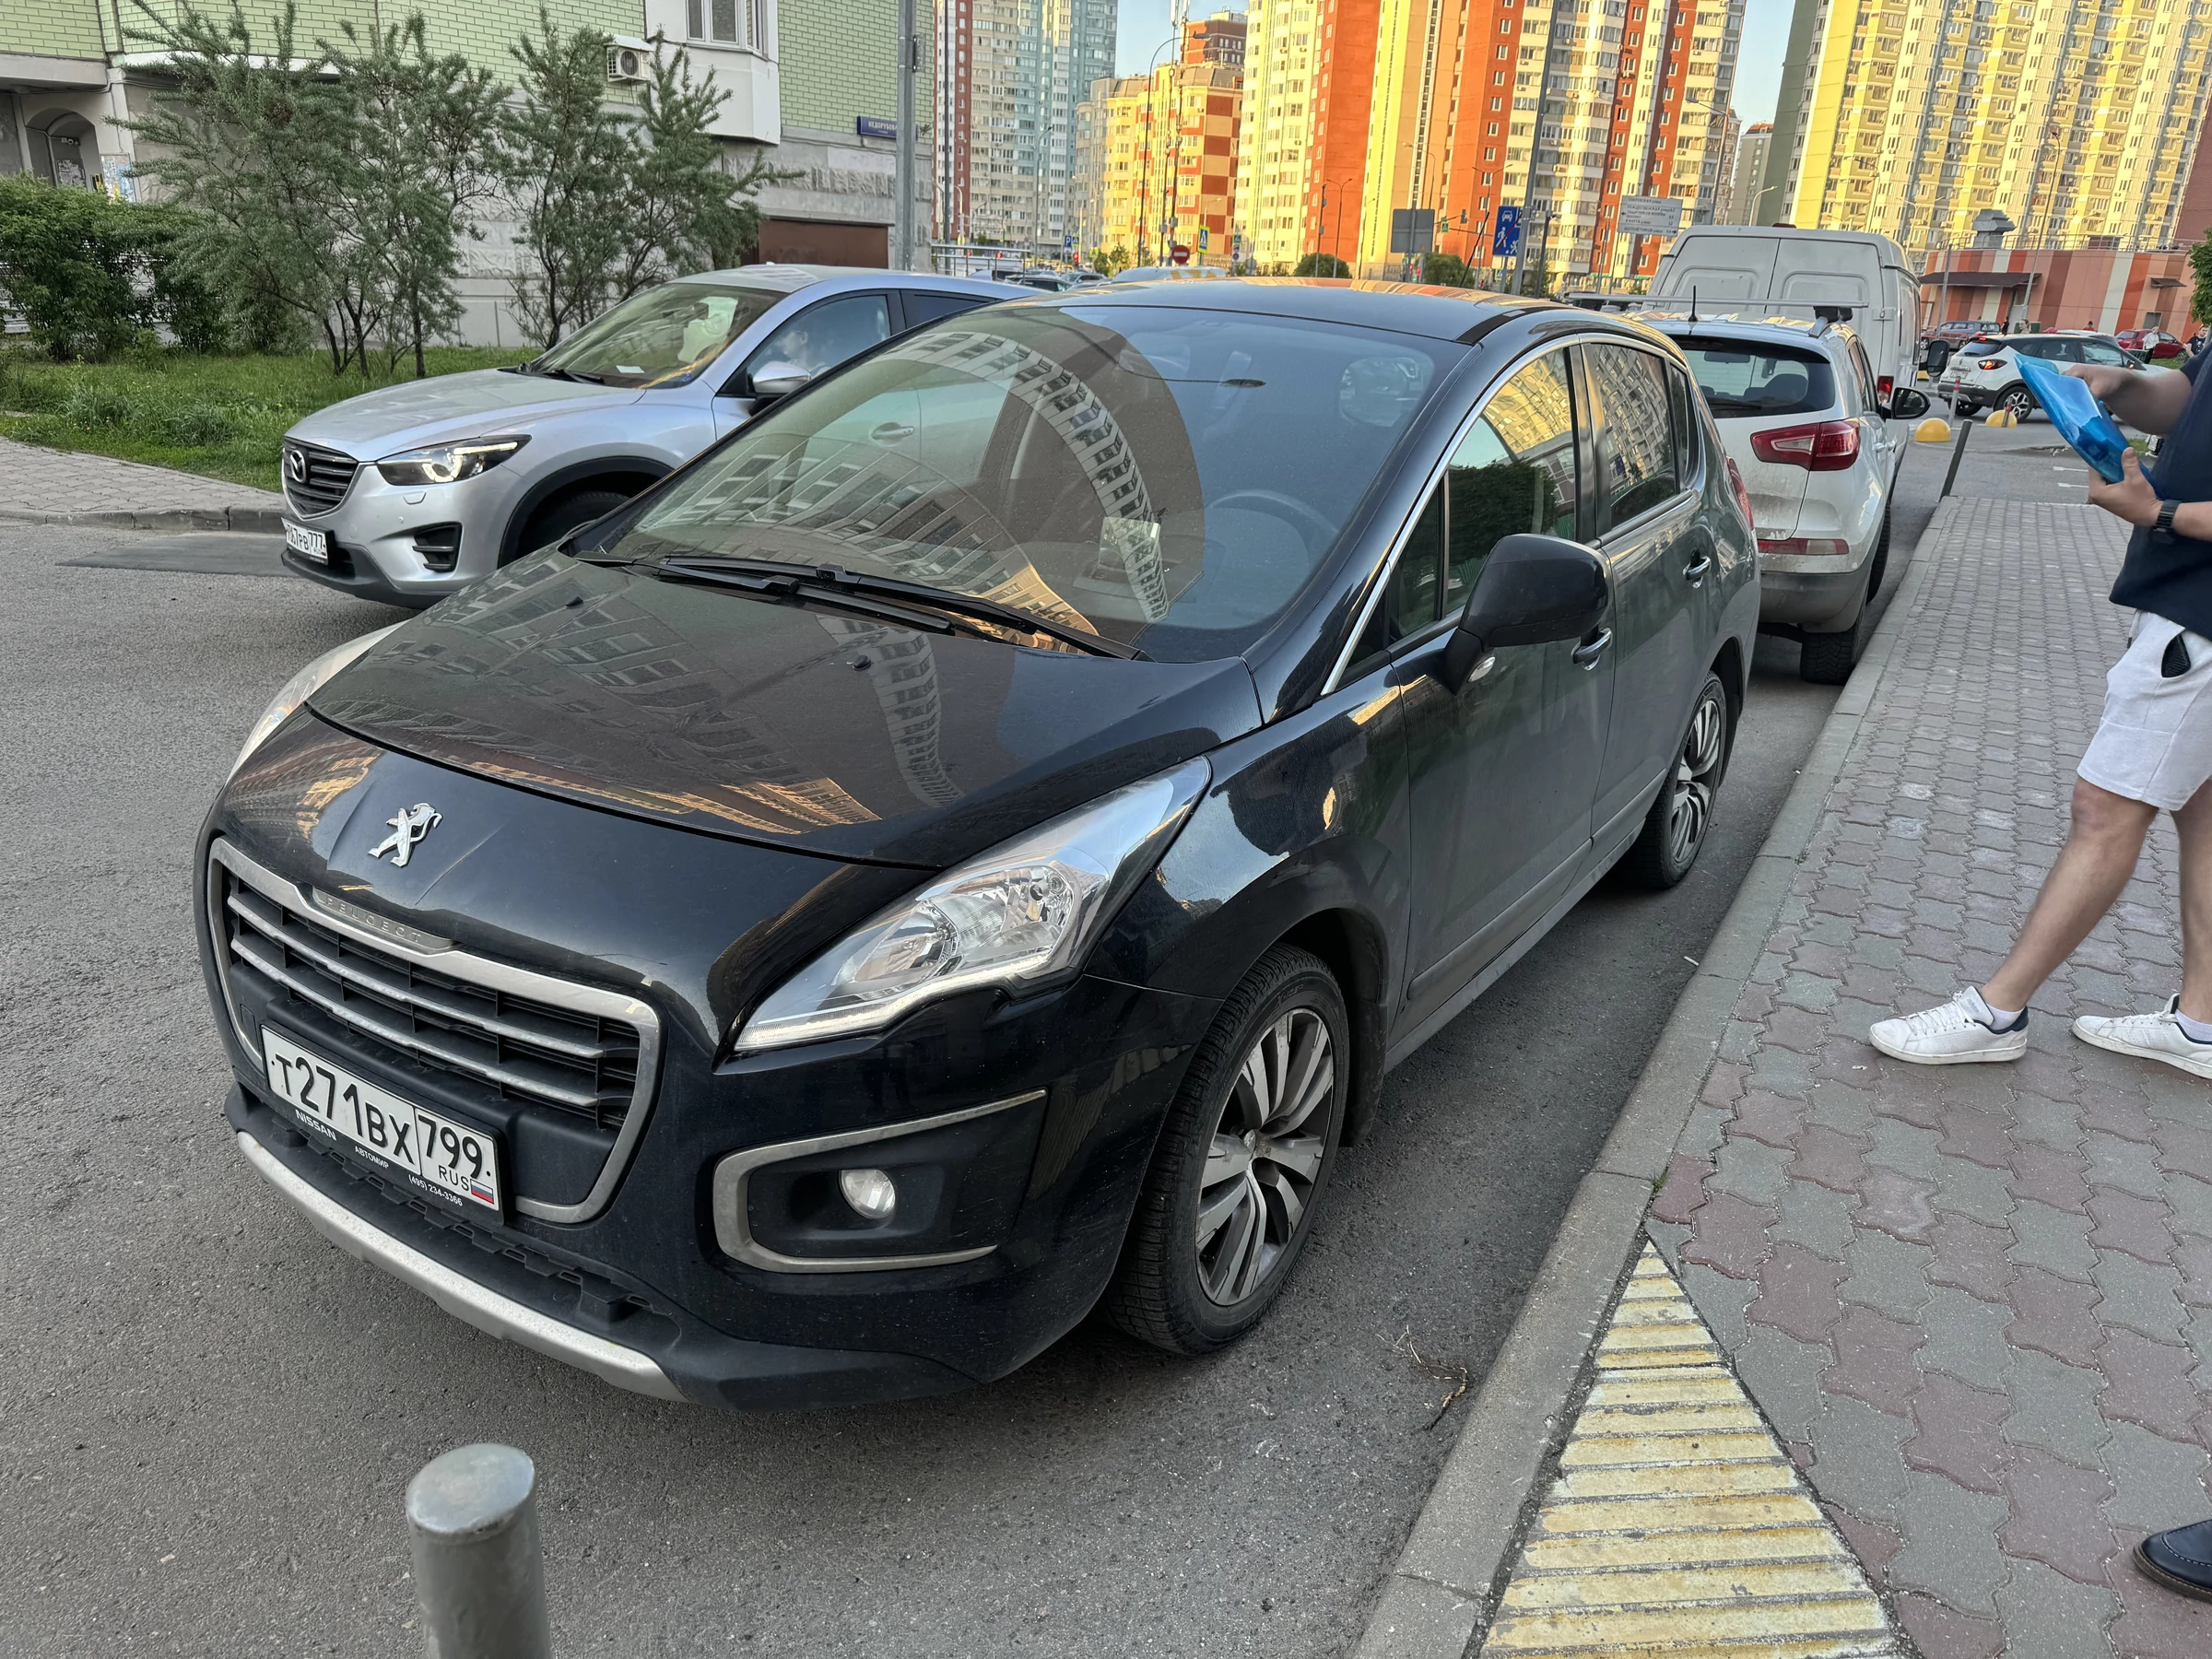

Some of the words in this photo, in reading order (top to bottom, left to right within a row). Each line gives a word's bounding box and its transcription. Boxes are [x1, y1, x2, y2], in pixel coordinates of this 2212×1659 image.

[326, 898, 421, 942] PEUGEOT
[295, 1109, 337, 1141] NISSAN
[355, 1146, 389, 1169] АВТОМИР
[408, 1174, 427, 1192] (495)
[428, 1183, 463, 1206] 234-3366
[438, 1165, 470, 1192] RUS
